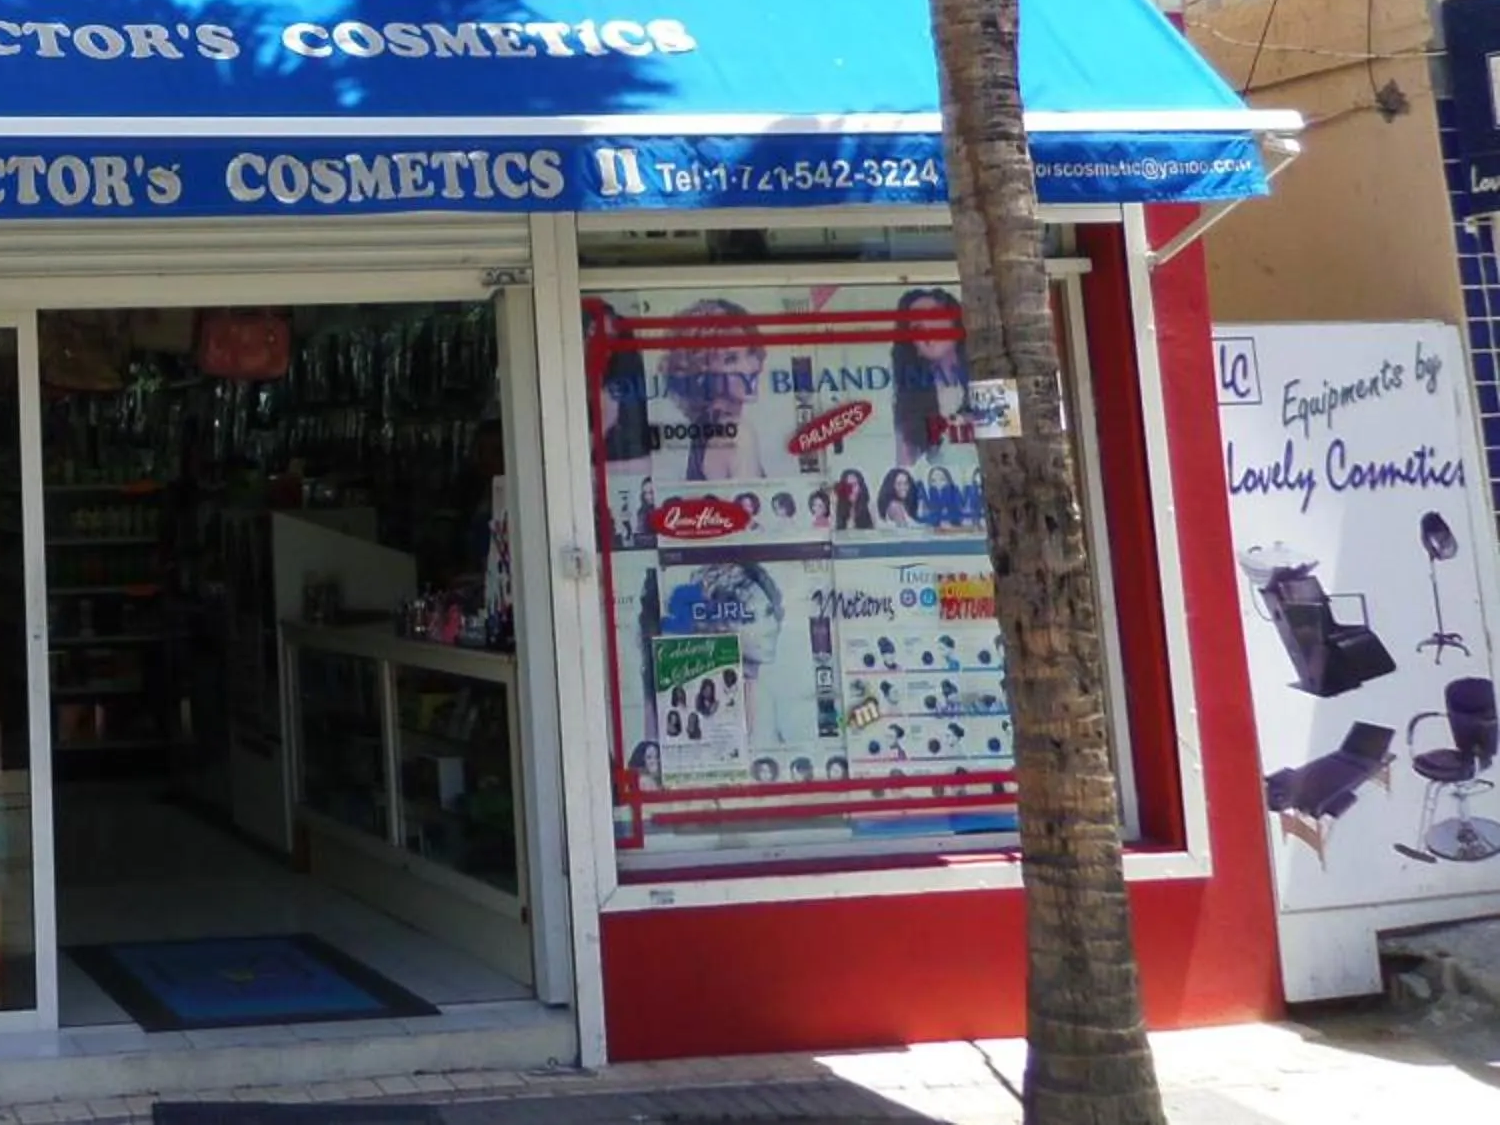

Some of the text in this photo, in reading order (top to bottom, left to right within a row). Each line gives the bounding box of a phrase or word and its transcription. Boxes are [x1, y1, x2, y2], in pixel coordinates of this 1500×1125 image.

[282, 18, 698, 61] COSMETICS
[226, 149, 565, 205] COSMETICS
[596, 147, 646, 196] II
[771, 365, 891, 394] BRAND
[1282, 341, 1442, 439] Equipments by
[799, 405, 865, 451] PALMER'S
[1227, 438, 1466, 514] Lovely Cosmetics
